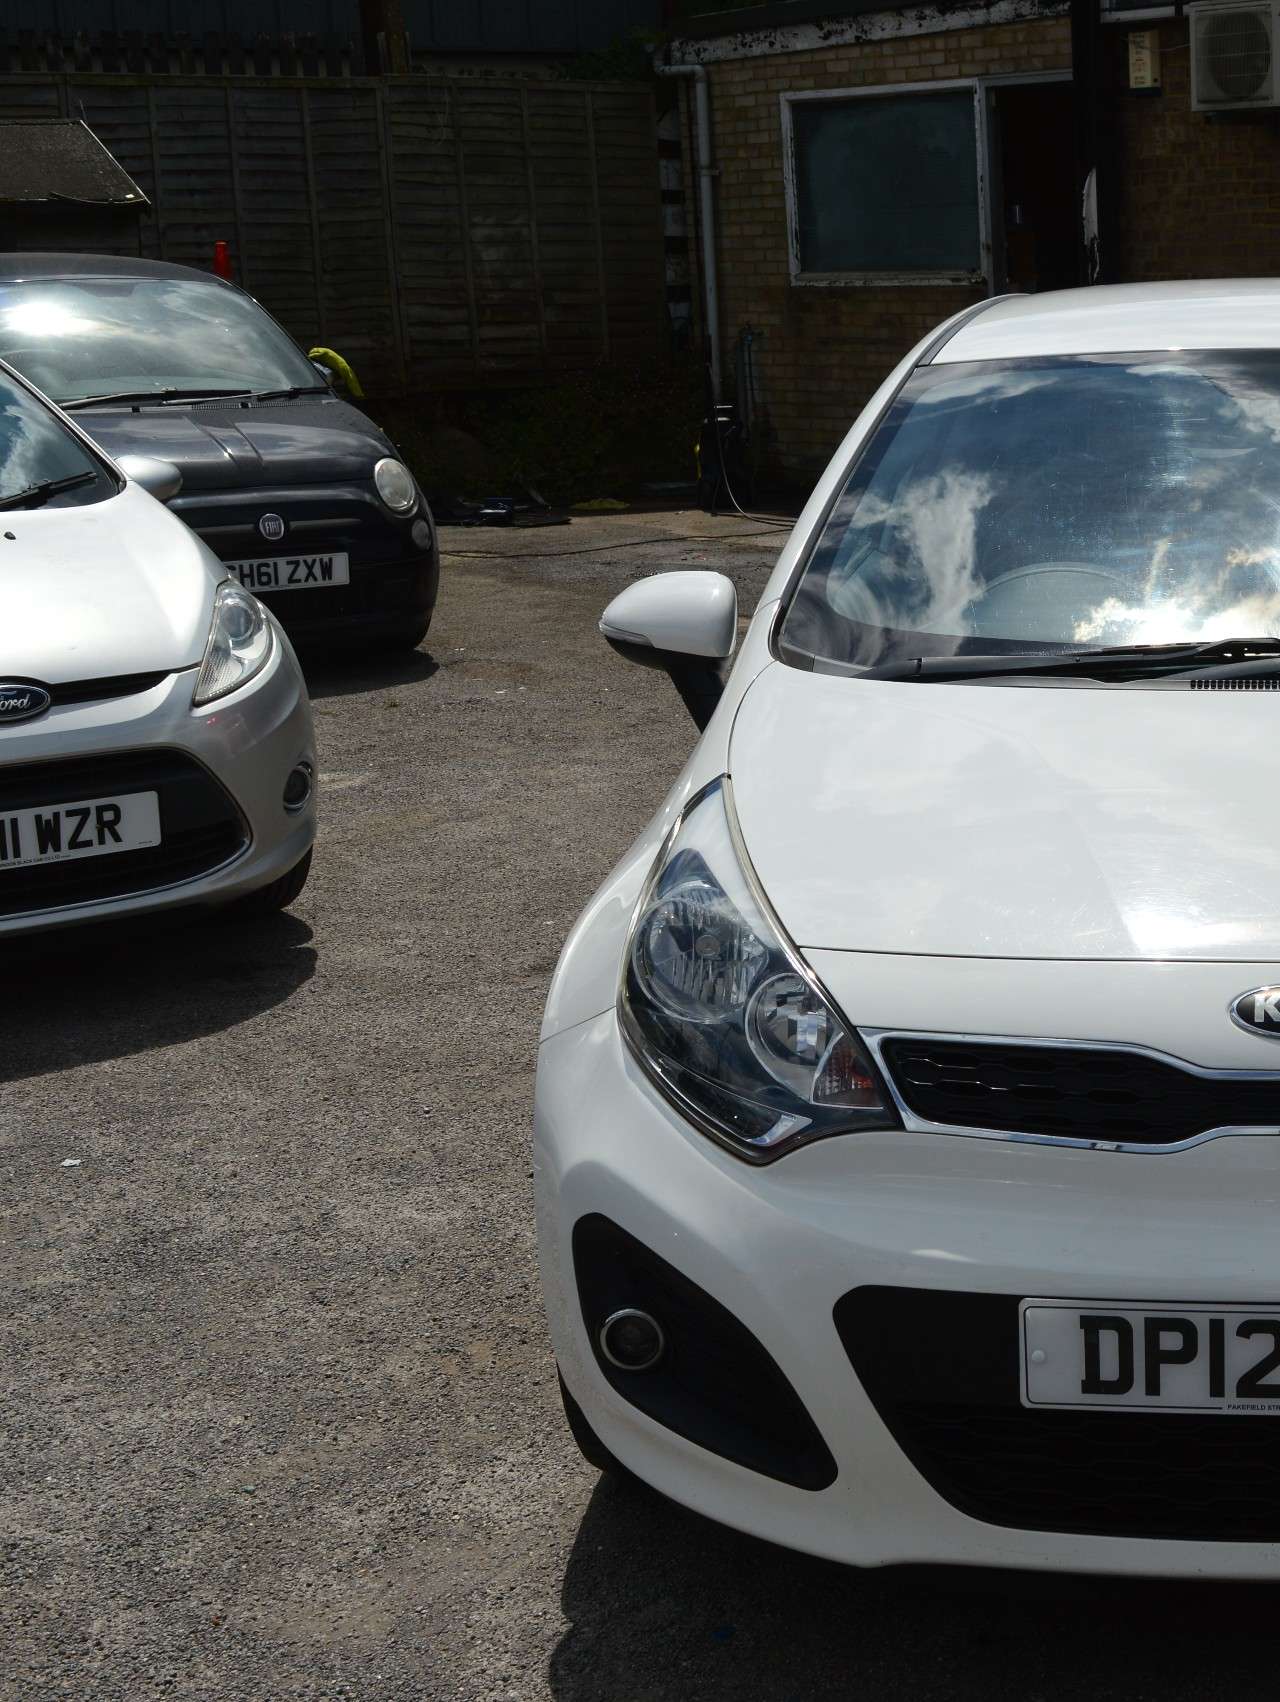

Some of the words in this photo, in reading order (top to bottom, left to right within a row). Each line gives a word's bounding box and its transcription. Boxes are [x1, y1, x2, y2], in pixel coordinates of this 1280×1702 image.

[286, 557, 334, 584] ZXW
[0, 690, 31, 711] ord
[34, 803, 123, 855] WZR
